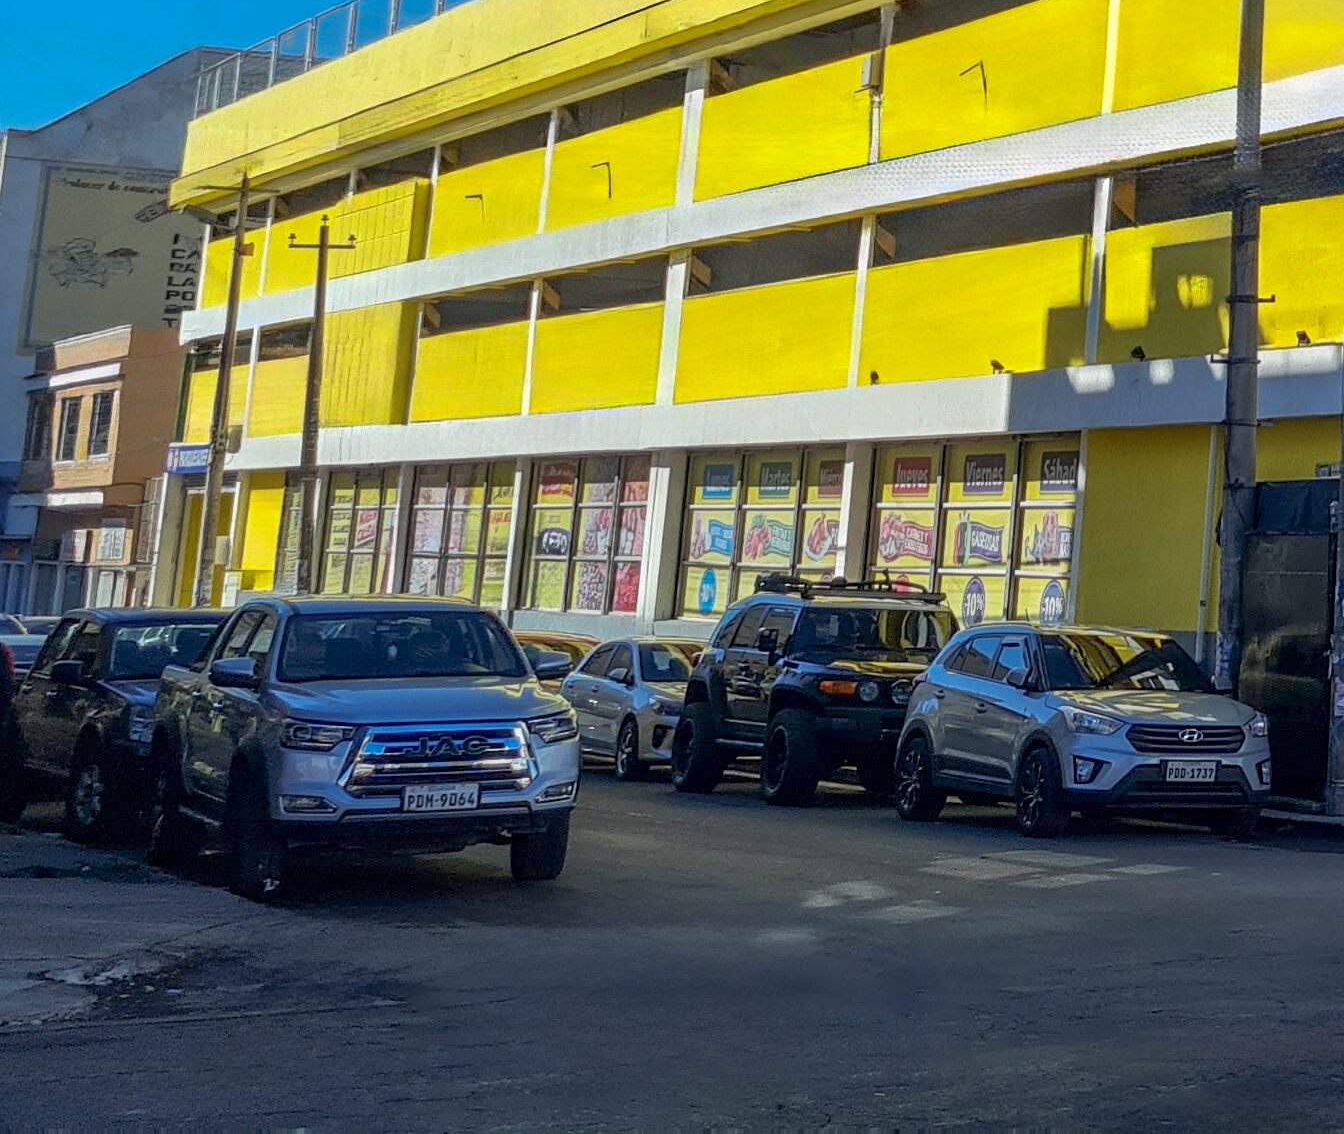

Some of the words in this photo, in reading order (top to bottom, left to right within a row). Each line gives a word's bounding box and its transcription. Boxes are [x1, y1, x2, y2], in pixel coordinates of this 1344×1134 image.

[894, 463, 928, 488] Jueves
[965, 462, 1004, 487] Viernes
[964, 593, 985, 616] -10%
[1042, 596, 1064, 621] -10%
[403, 735, 489, 758] JAC
[407, 790, 475, 811] PDM-9064
